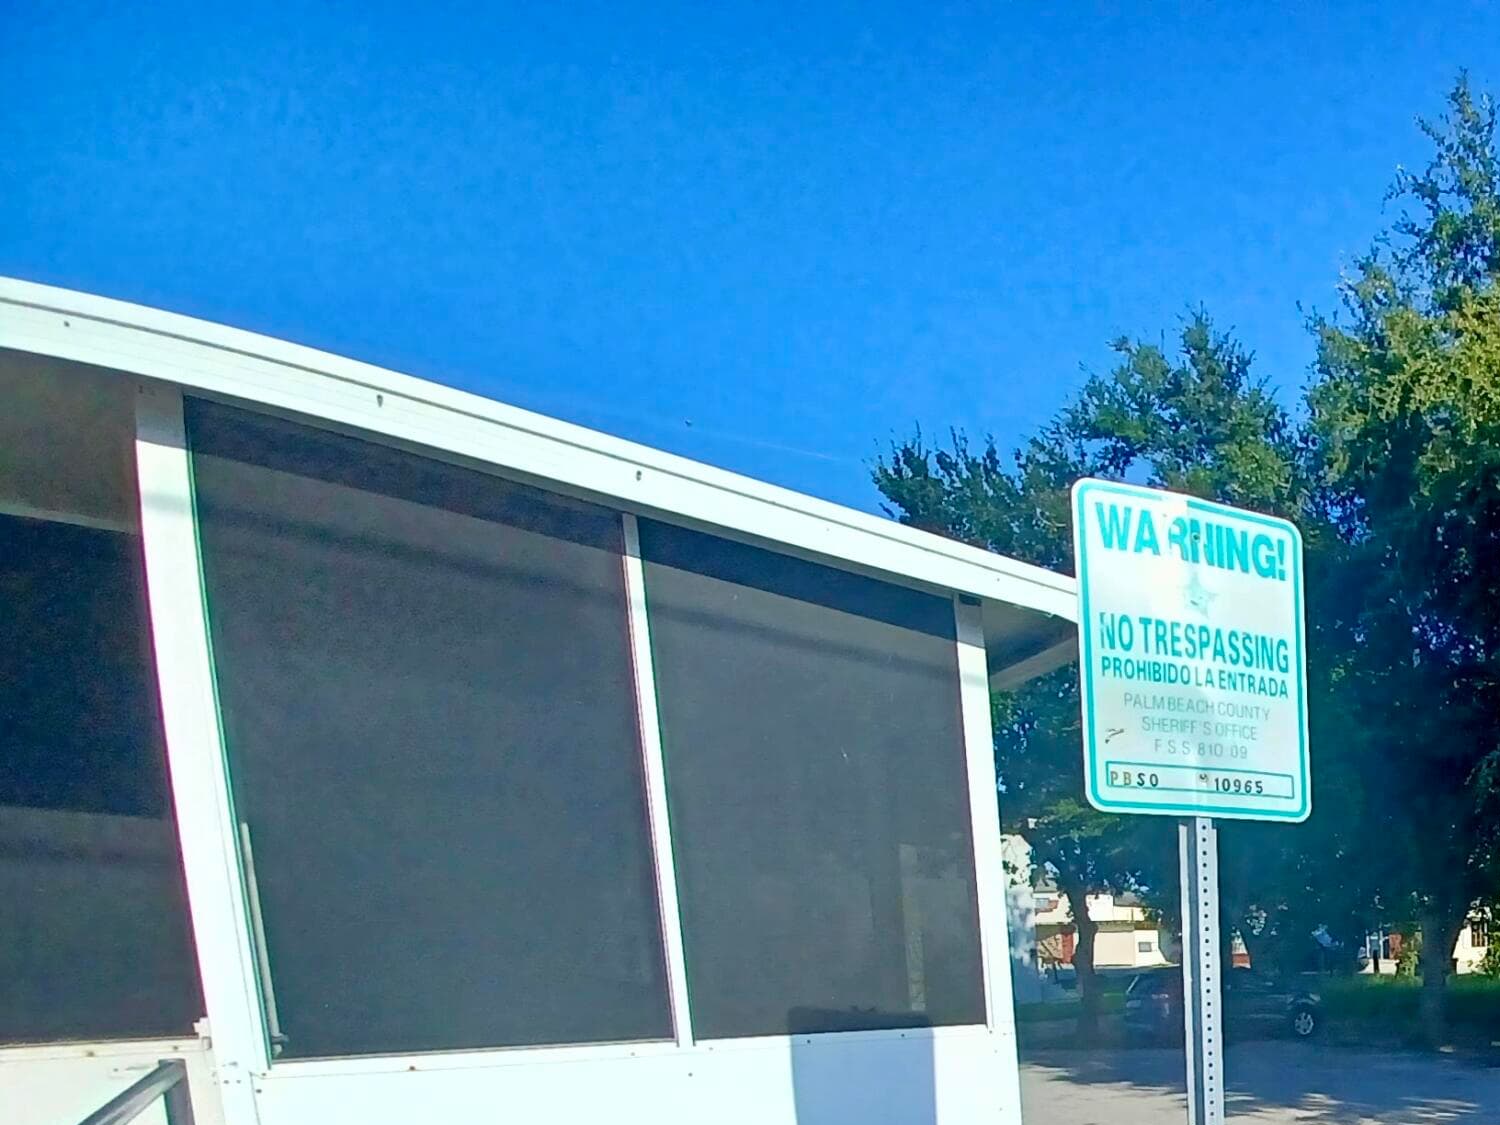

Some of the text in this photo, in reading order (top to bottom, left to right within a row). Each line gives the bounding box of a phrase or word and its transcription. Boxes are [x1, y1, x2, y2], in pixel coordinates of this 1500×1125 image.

[1095, 502, 1287, 581] WARNING!
[1099, 612, 1289, 673] NO TRESPASSING
[1101, 656, 1289, 699] PROHIBIDO LA ENTRADA
[1124, 692, 1272, 721] PALM BEACH COUNTY
[1215, 722, 1257, 741] OFFICE
[1214, 777, 1264, 794] 10965
